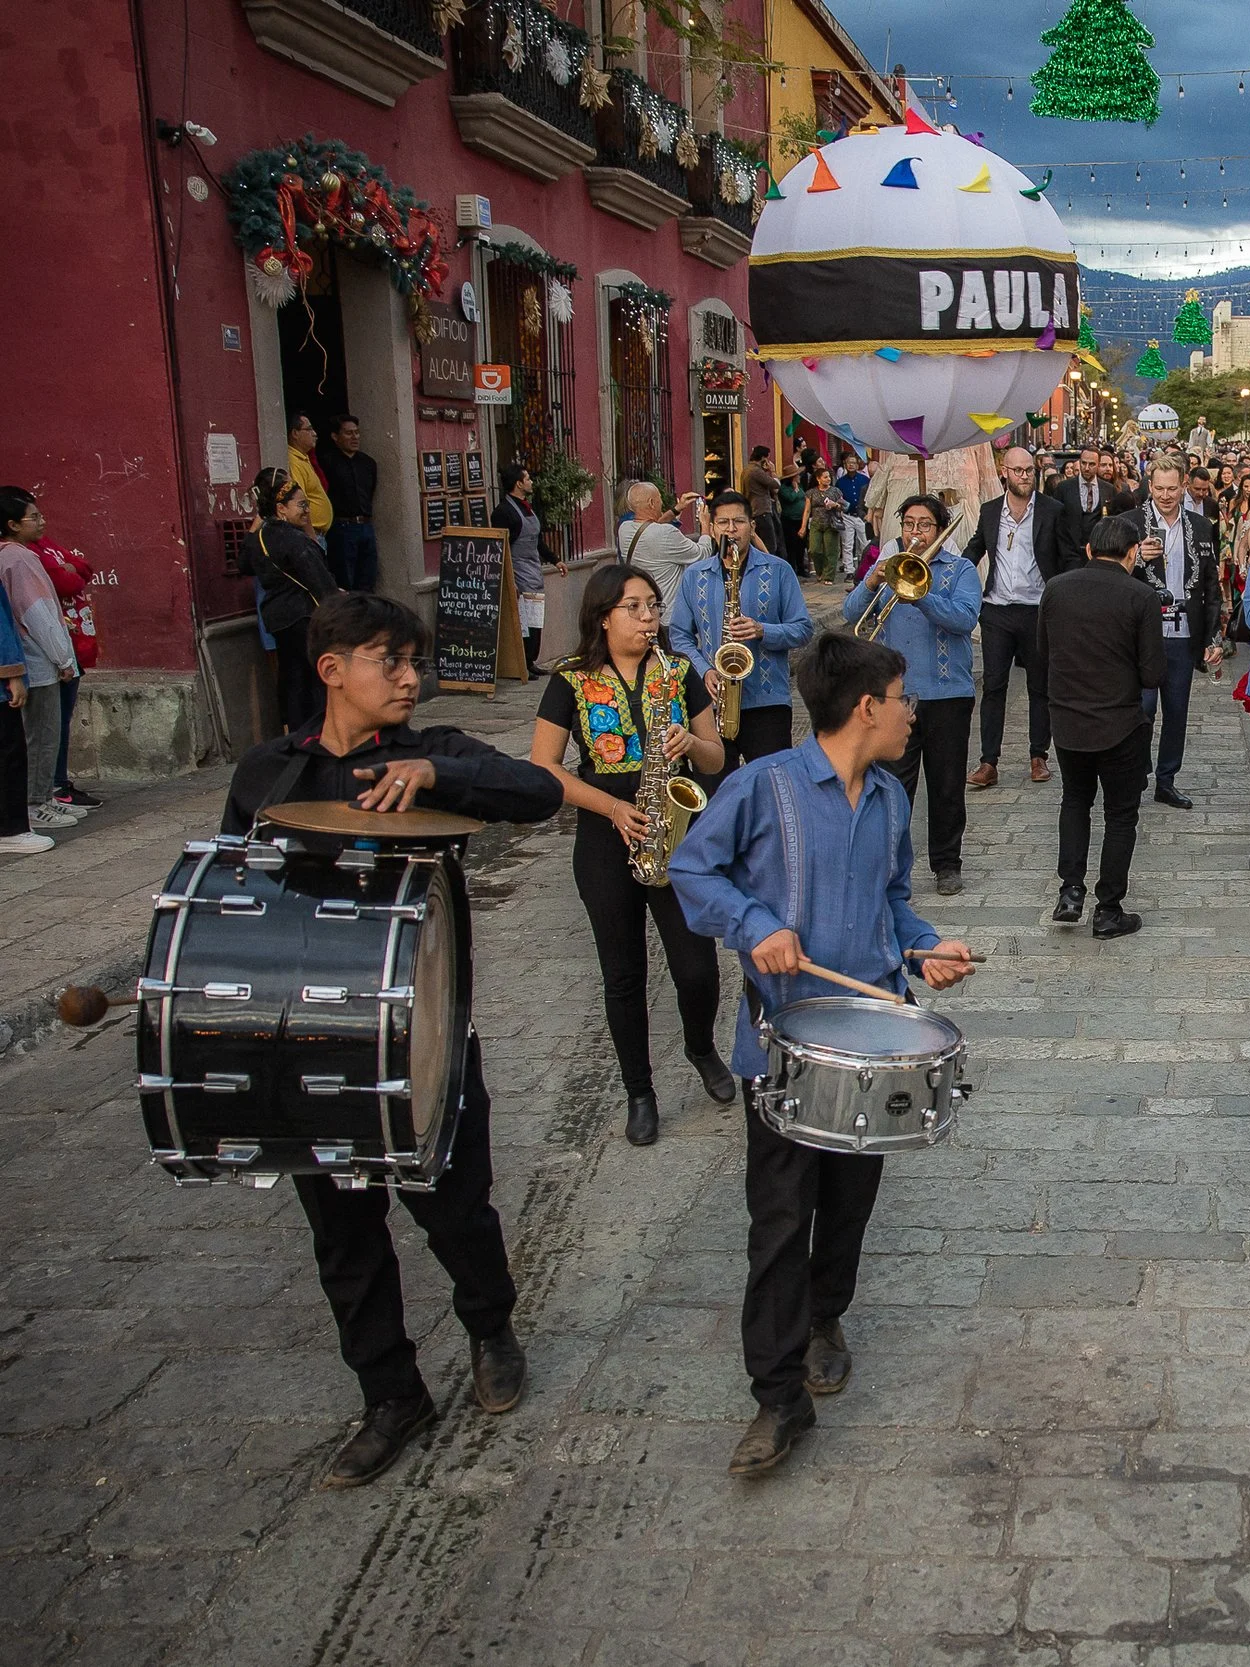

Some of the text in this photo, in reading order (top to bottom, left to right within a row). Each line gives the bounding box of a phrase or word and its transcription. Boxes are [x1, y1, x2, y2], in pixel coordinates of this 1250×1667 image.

[919, 270, 1070, 331] PAULA
[430, 315, 468, 342] DIFICIO
[429, 358, 470, 381] ALCALA
[705, 394, 738, 406] OAXUM
[466, 541, 502, 564] Azotea
[88, 569, 119, 586] alá
[441, 586, 459, 600] Una
[482, 589, 491, 600] de
[450, 644, 487, 658] Postres
[474, 663, 491, 671] vivo
